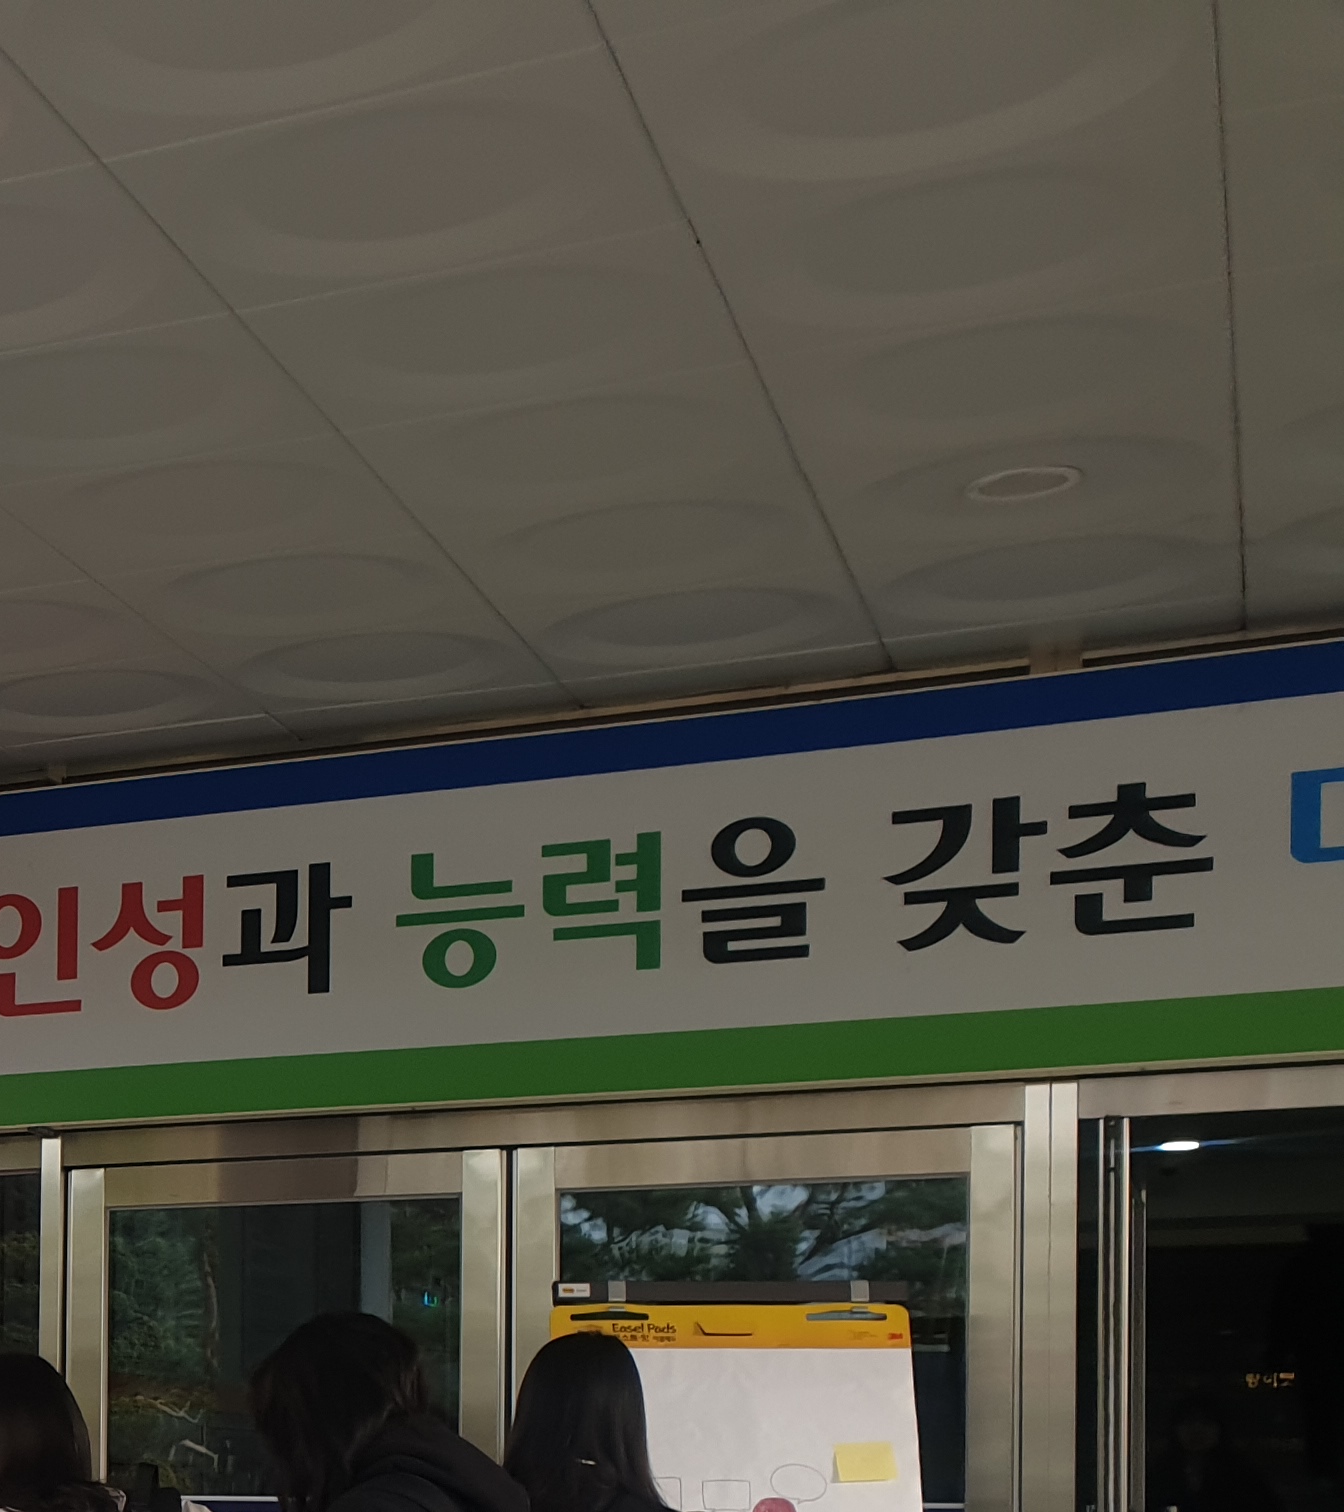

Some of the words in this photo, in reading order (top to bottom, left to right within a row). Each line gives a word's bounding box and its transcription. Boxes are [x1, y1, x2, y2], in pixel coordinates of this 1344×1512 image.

[396, 817, 825, 988] 능력을
[882, 782, 1214, 951] 갖춘
[612, 1323, 644, 1334] Easel
[647, 1323, 677, 1334] Pads
